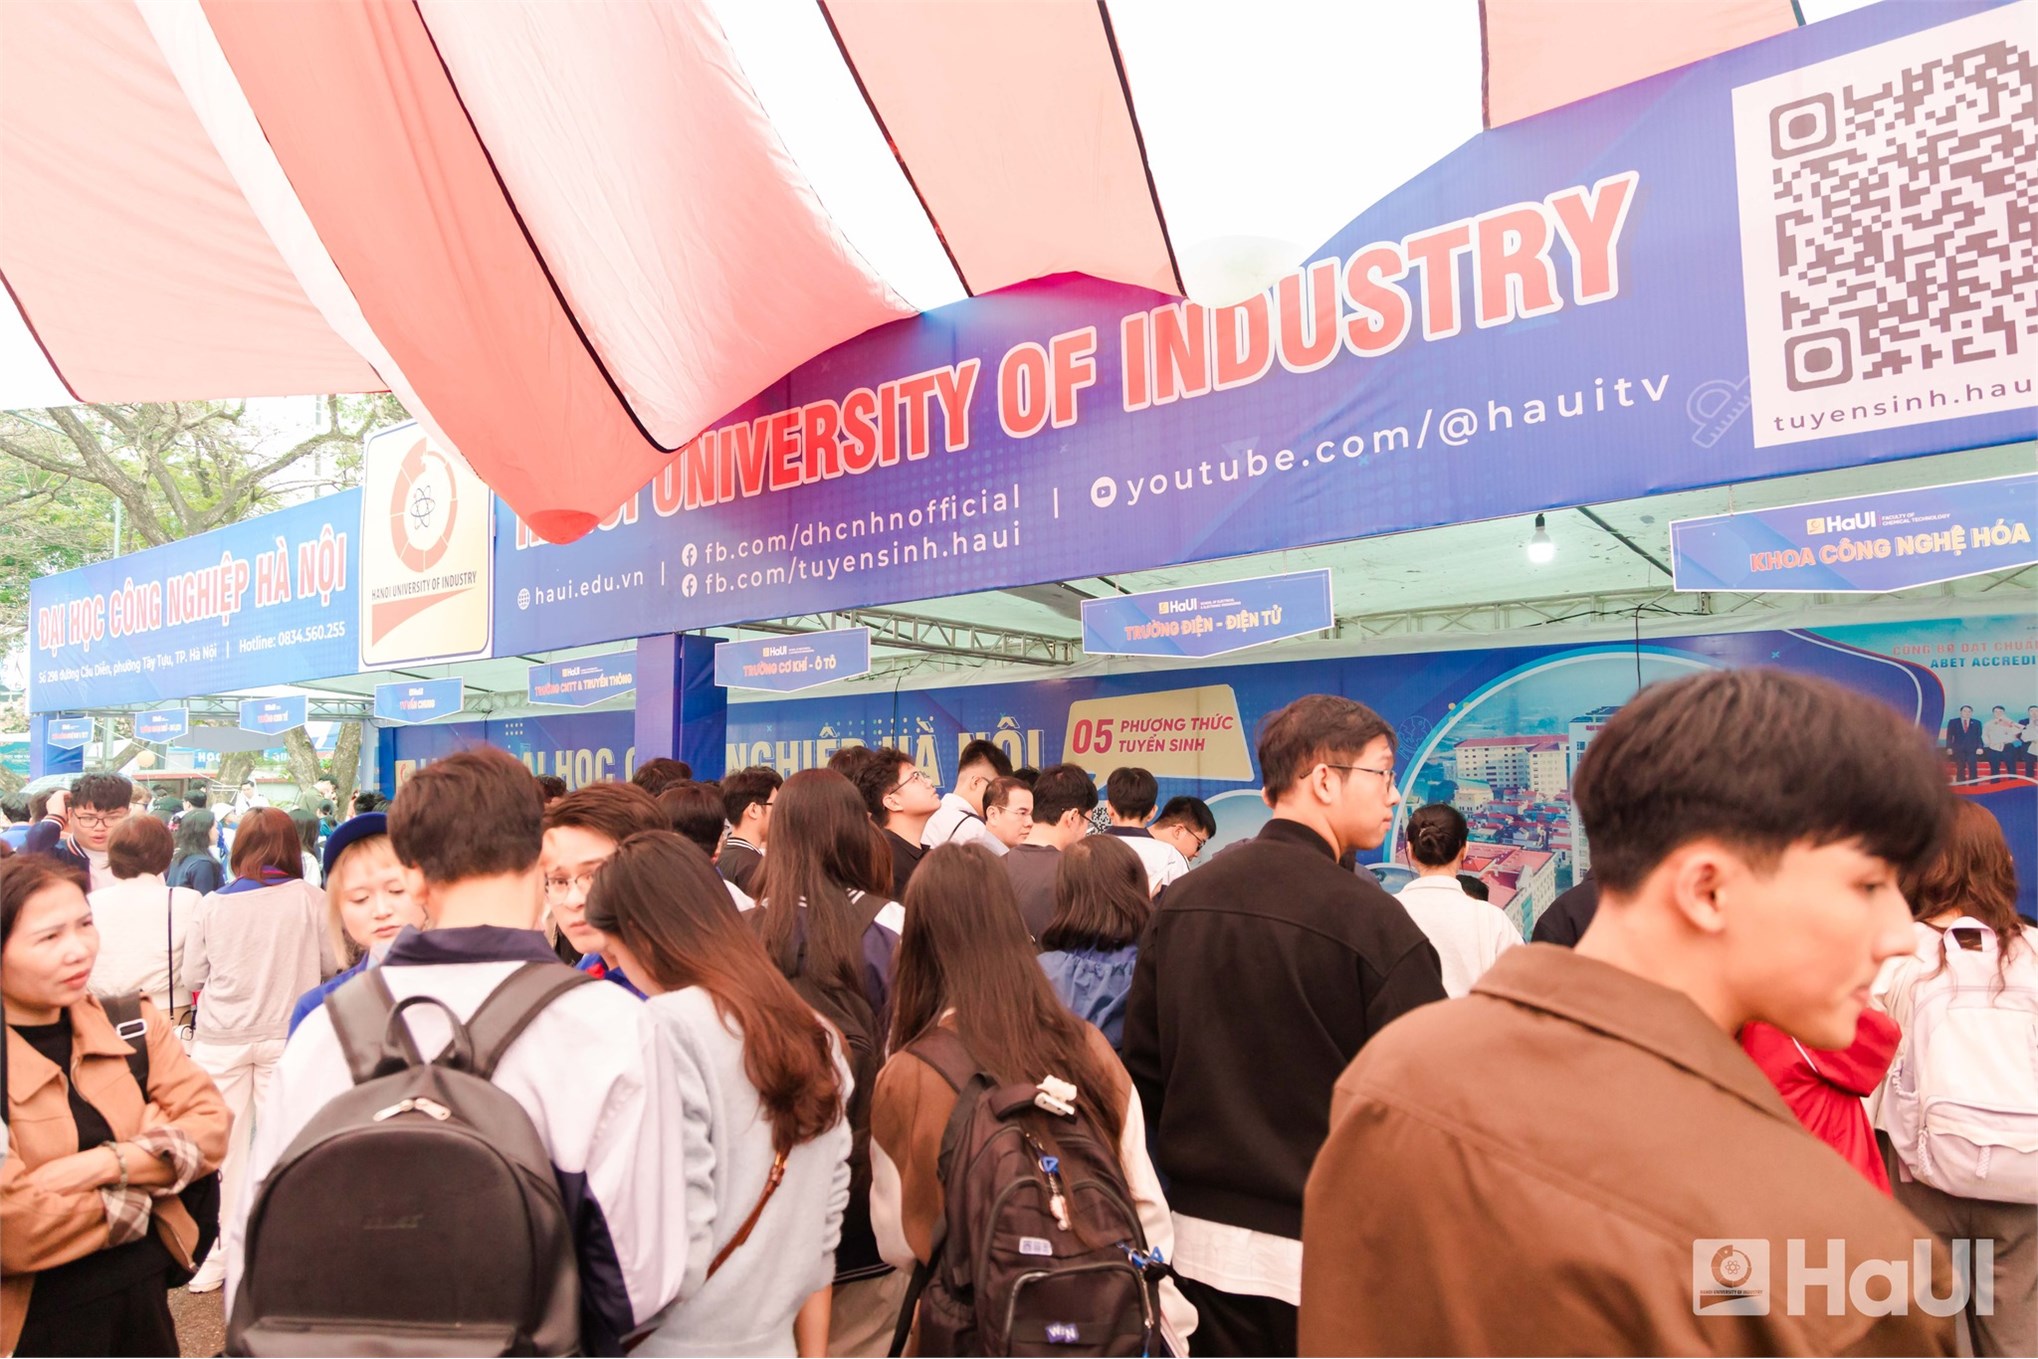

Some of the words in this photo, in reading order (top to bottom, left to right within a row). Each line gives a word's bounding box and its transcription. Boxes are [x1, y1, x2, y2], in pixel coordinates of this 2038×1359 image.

[652, 357, 980, 517] UNIVERSITY
[998, 325, 1097, 439] OF
[1121, 170, 1639, 412] INDUSTRY
[1126, 374, 1670, 505] youtube.com/@hauitv
[705, 483, 1019, 564] fb.com/dhcnhnofficial
[1827, 511, 1876, 533] HaUI
[705, 520, 1020, 594] fb.com/tuyensinh.haui
[1751, 547, 1816, 572] KHOA
[1819, 537, 1892, 564] CÔNG
[1895, 524, 1966, 557] NGHỆ
[1970, 518, 2031, 548] HÓA
[39, 603, 65, 657] ĐẠI
[69, 594, 104, 652] HỌC
[110, 576, 161, 638] CÔNG
[167, 551, 249, 627] NGHIỆP
[255, 535, 291, 607] HÀ
[298, 523, 346, 607] NỘI
[392, 578, 431, 598] UNIVERSITY
[431, 577, 440, 591] OF
[441, 571, 477, 589] INDUSTRY
[535, 570, 644, 605] haui.edu.vn
[1124, 619, 1180, 641] TRƯỜNG
[1181, 615, 1213, 637] ĐIỆN
[1226, 609, 1259, 632] ĐIỆN
[1261, 604, 1282, 626] TỬ
[1170, 598, 1197, 613] HaUI
[239, 635, 275, 653] Hotline:
[278, 621, 346, 646] 0834.560.255
[175, 650, 188, 664] TP.
[189, 648, 200, 663] Hà
[1931, 657, 1966, 669] ABET
[1072, 718, 1114, 754] 05
[1120, 718, 1186, 733] PHƯƠNG
[1191, 713, 1234, 731] THỨC
[1119, 734, 1165, 753] TUYỂN
[1169, 738, 1206, 752] SINH
